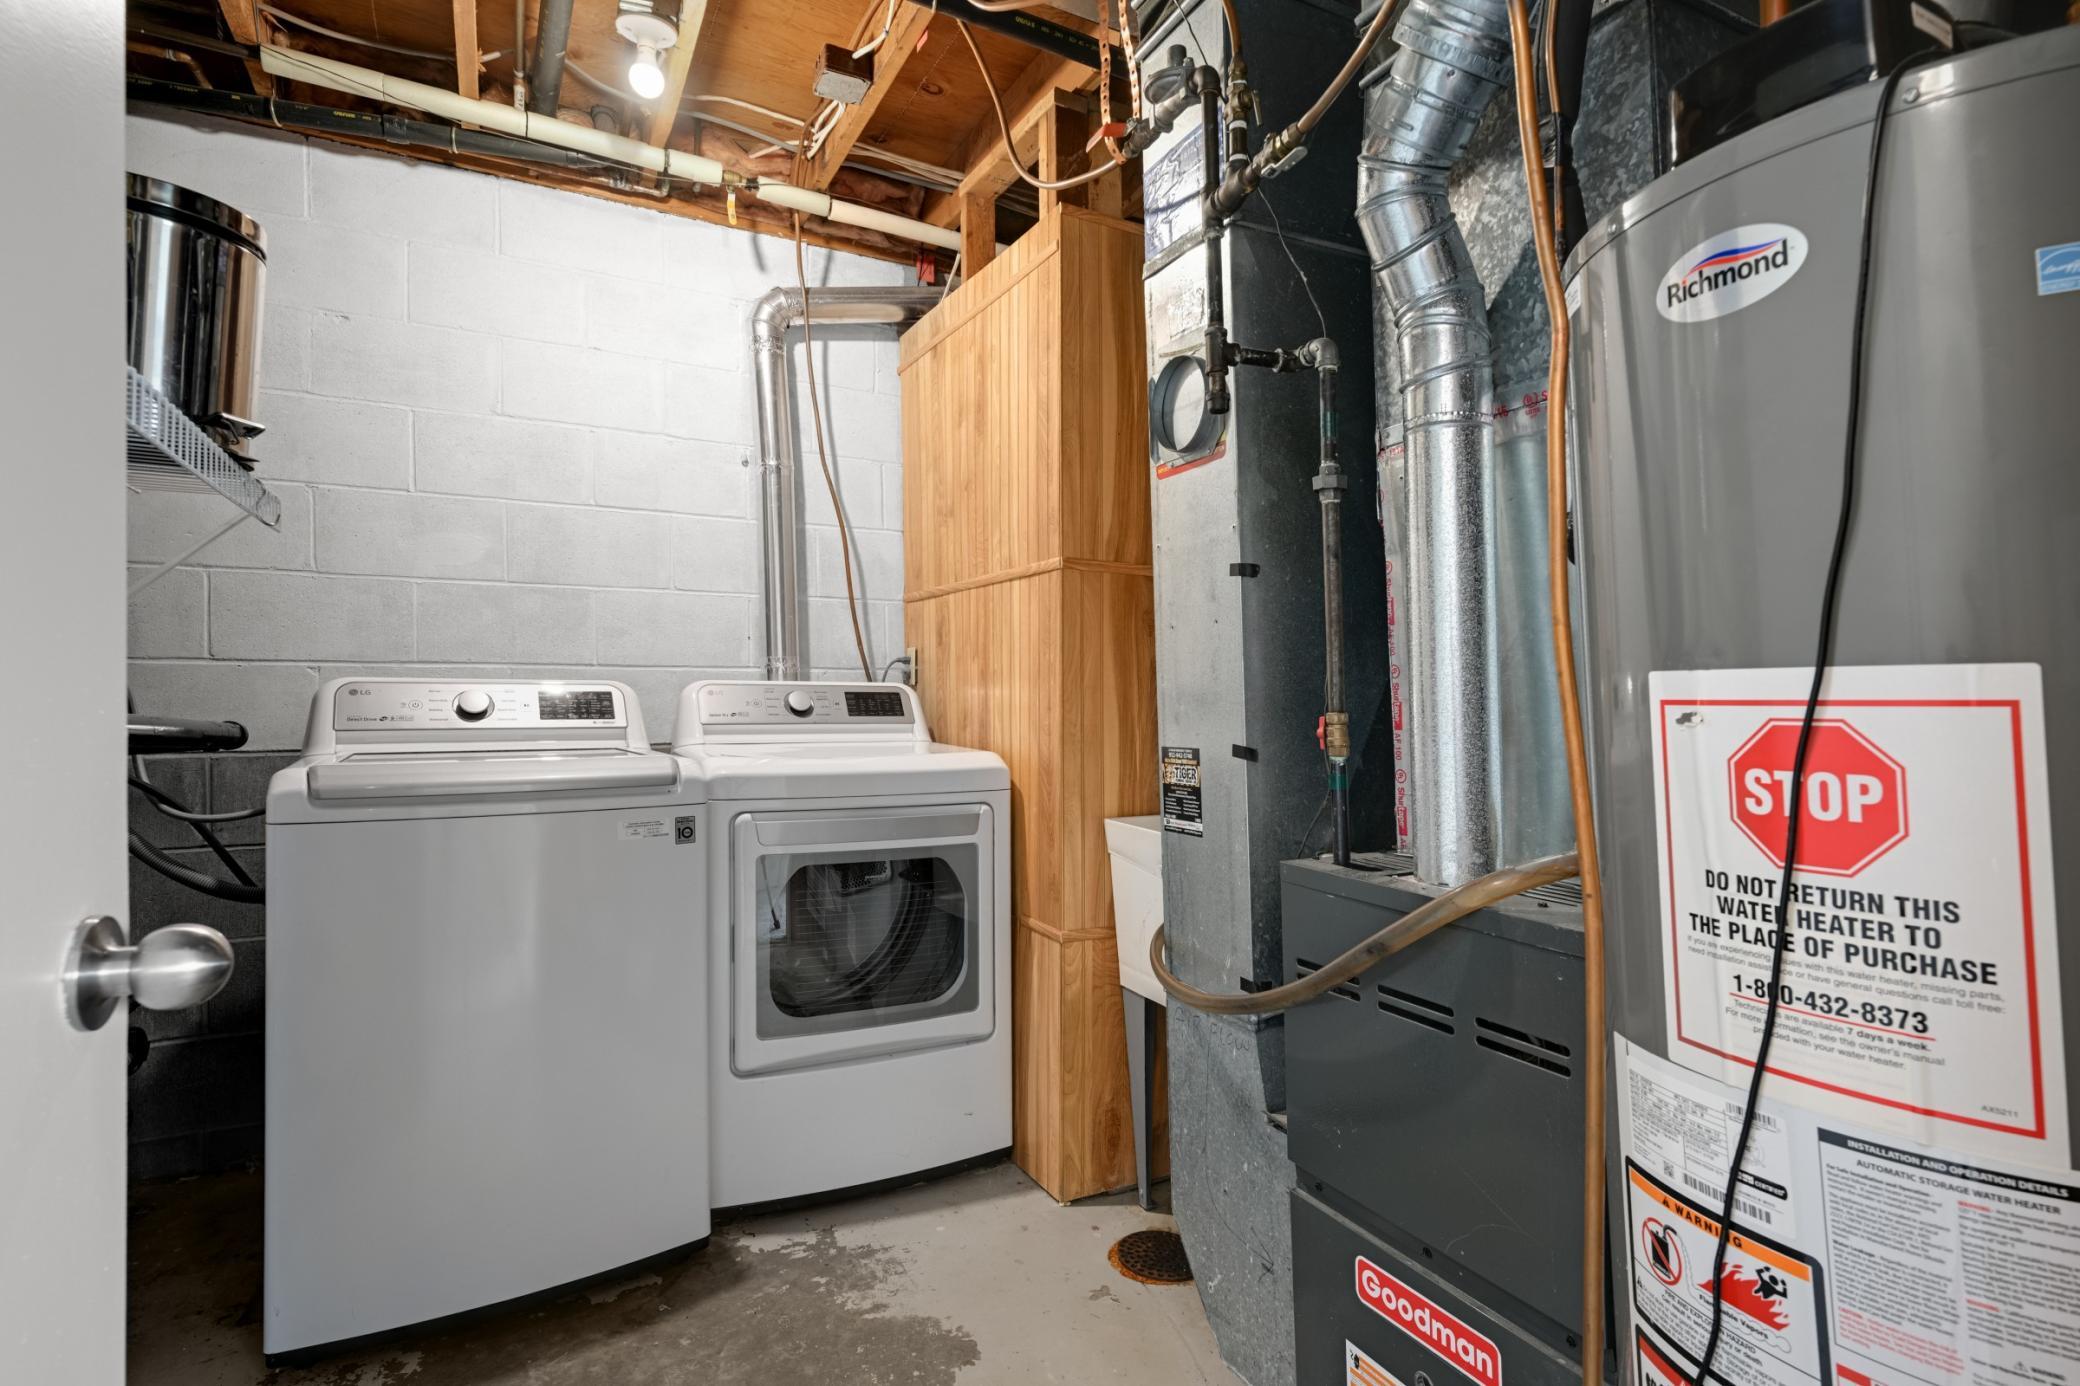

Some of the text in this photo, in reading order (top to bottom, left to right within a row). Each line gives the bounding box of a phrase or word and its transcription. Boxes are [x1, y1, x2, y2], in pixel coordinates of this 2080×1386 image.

[1667, 238, 1788, 308] Richmond
[1175, 766, 1197, 780] TIGER
[1744, 768, 1884, 823] STOP
[1705, 869, 1960, 924] DO NOT RETURN THIS
[1688, 912, 1998, 986] THE PLACE OF PURCHASE
[1797, 909, 1895, 943] HEATER
[1904, 924, 1942, 949] TO
[1804, 962, 1824, 972] with
[1826, 965, 1844, 976] this
[1847, 970, 1876, 981] water
[1920, 983, 1967, 998] missing
[1807, 973, 1831, 984] have
[1833, 979, 1872, 992] general
[1875, 986, 1929, 1002] questions
[1932, 996, 1953, 1005] call
[1740, 1012, 1762, 1023] more
[1819, 1033, 1837, 1042] see
[1839, 1037, 1856, 1047] the
[1903, 1051, 1946, 1066] manual
[1792, 1037, 1811, 1047] with
[1837, 1048, 1866, 1060] water
[1856, 1030, 1884, 1042] days
[1847, 1139, 2069, 1198] INSTALLATION AND OPERATION DETAILS
[1856, 1160, 2062, 1215] AUTOMATIC STORAGE WATER HEATER
[1361, 1269, 1494, 1380] Goodman
[1740, 1319, 1769, 1340] Vapors
